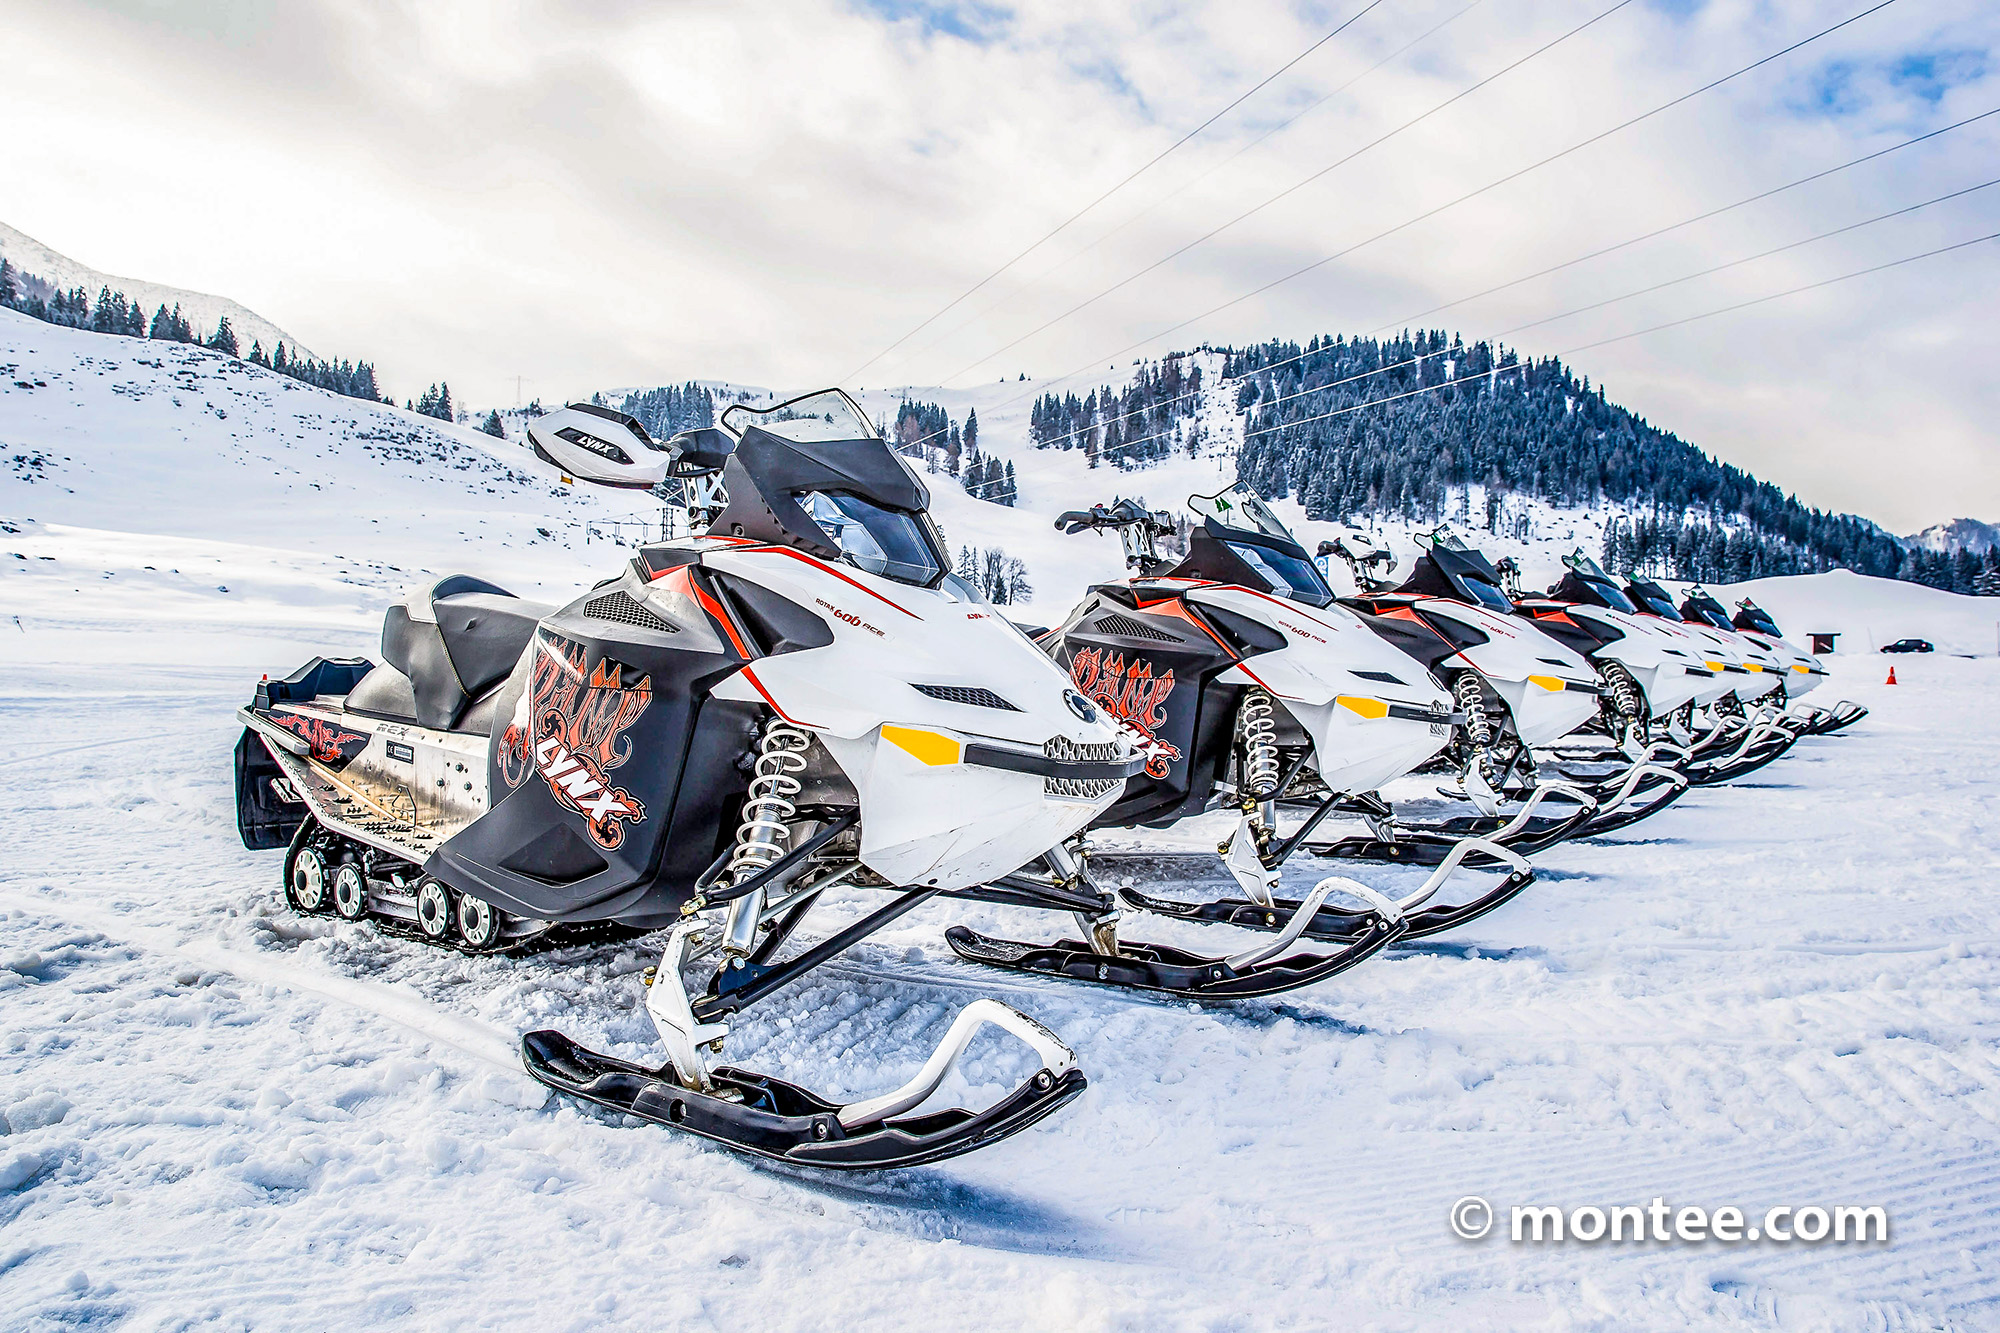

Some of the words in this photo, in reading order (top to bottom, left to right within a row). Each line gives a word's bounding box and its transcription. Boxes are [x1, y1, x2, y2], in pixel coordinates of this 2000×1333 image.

[577, 435, 615, 454] LYNX
[815, 597, 835, 611] ROTAX
[862, 622, 886, 637] ACE
[1291, 626, 1311, 638] 600
[376, 723, 410, 737] REX
[535, 735, 635, 823] LYNX
